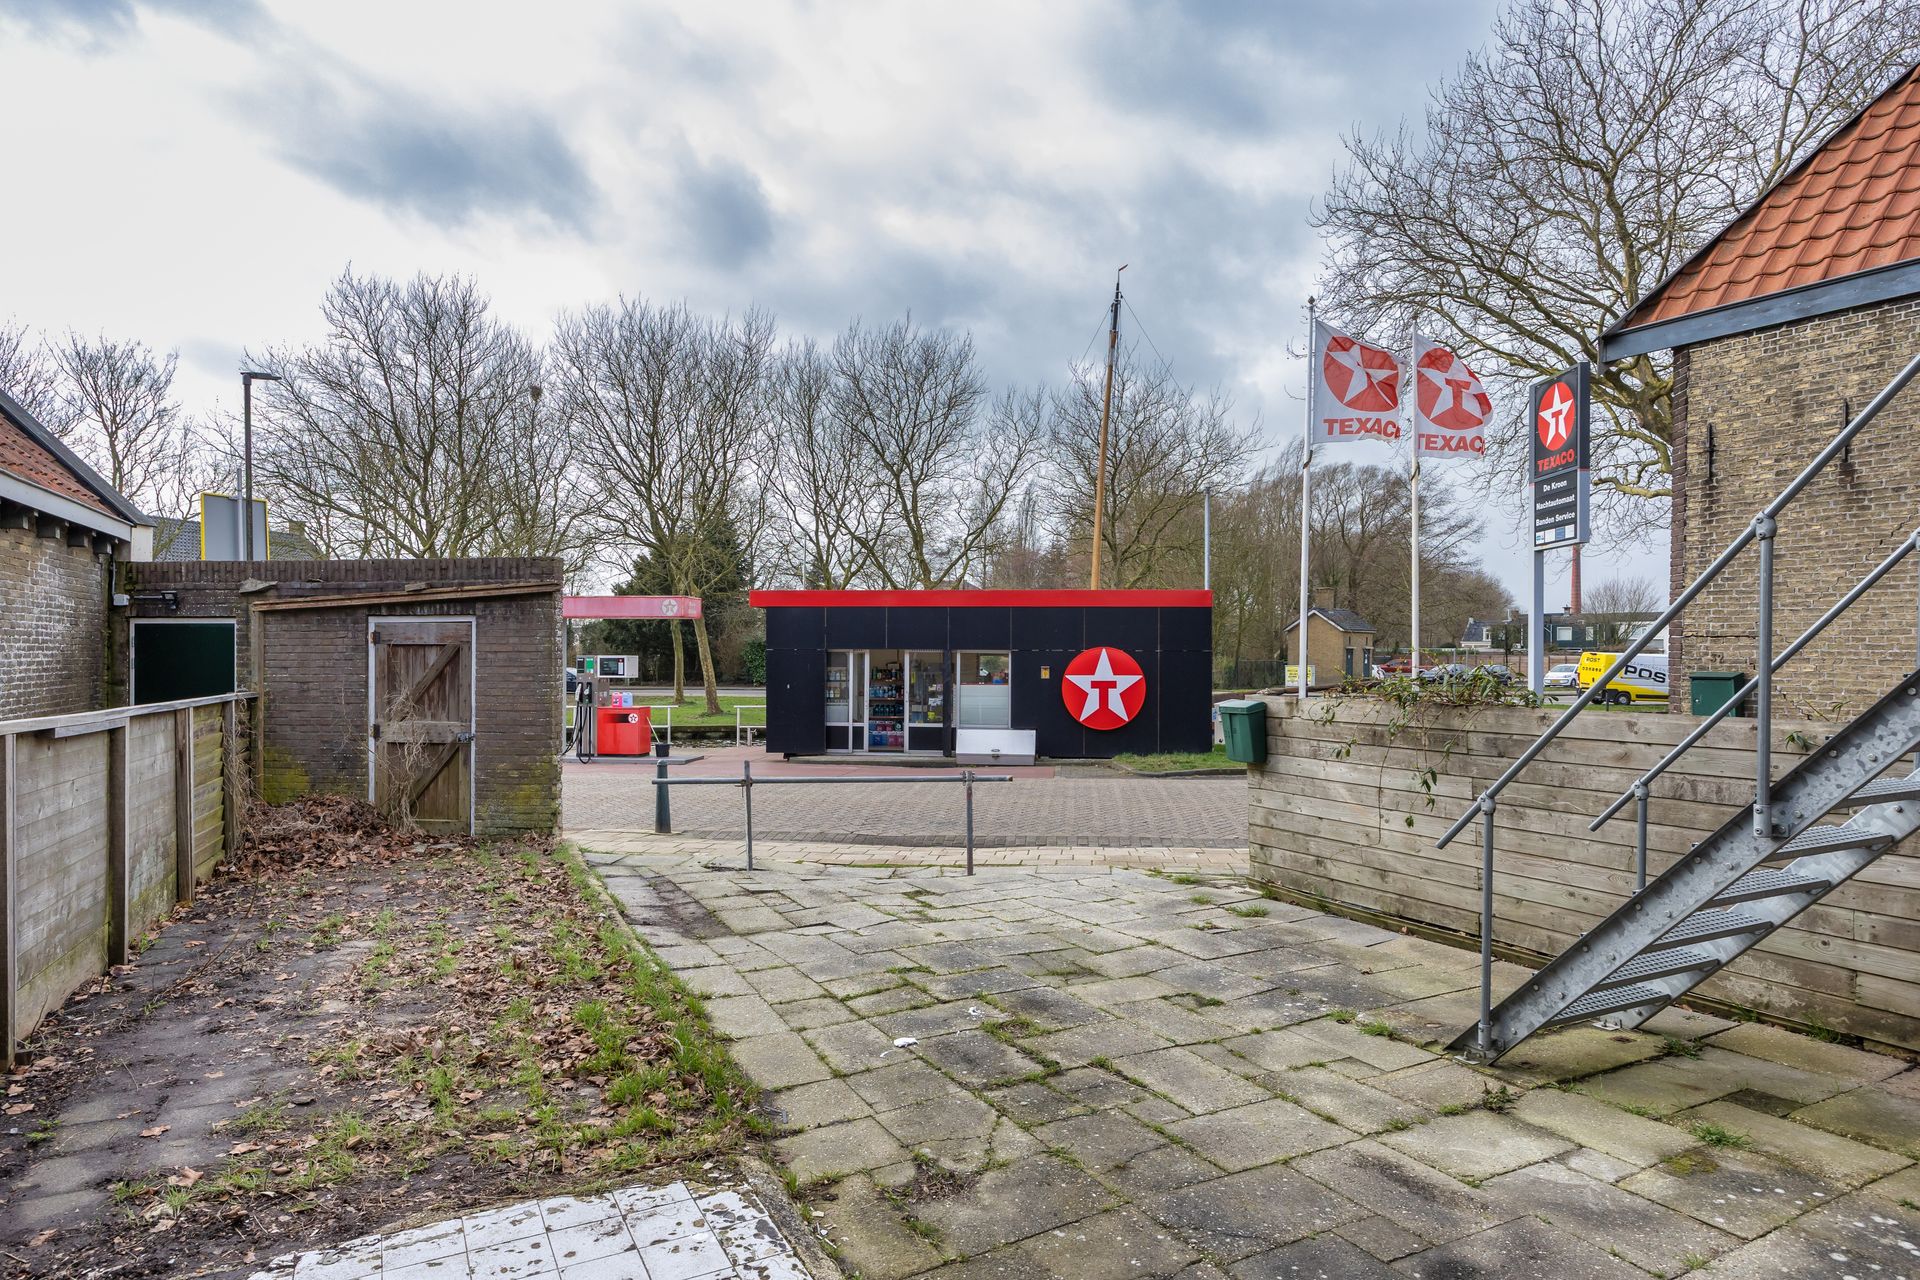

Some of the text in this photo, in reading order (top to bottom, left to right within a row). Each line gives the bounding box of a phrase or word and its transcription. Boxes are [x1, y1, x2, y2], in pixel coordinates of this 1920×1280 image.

[1418, 433, 1486, 454] TEXAC
[1537, 448, 1575, 472] TEXACO
[1543, 480, 1567, 492] De Kroon
[1536, 494, 1575, 510] Nachtautomaat
[1536, 511, 1576, 527] Banden Service
[1624, 664, 1667, 683] POS
